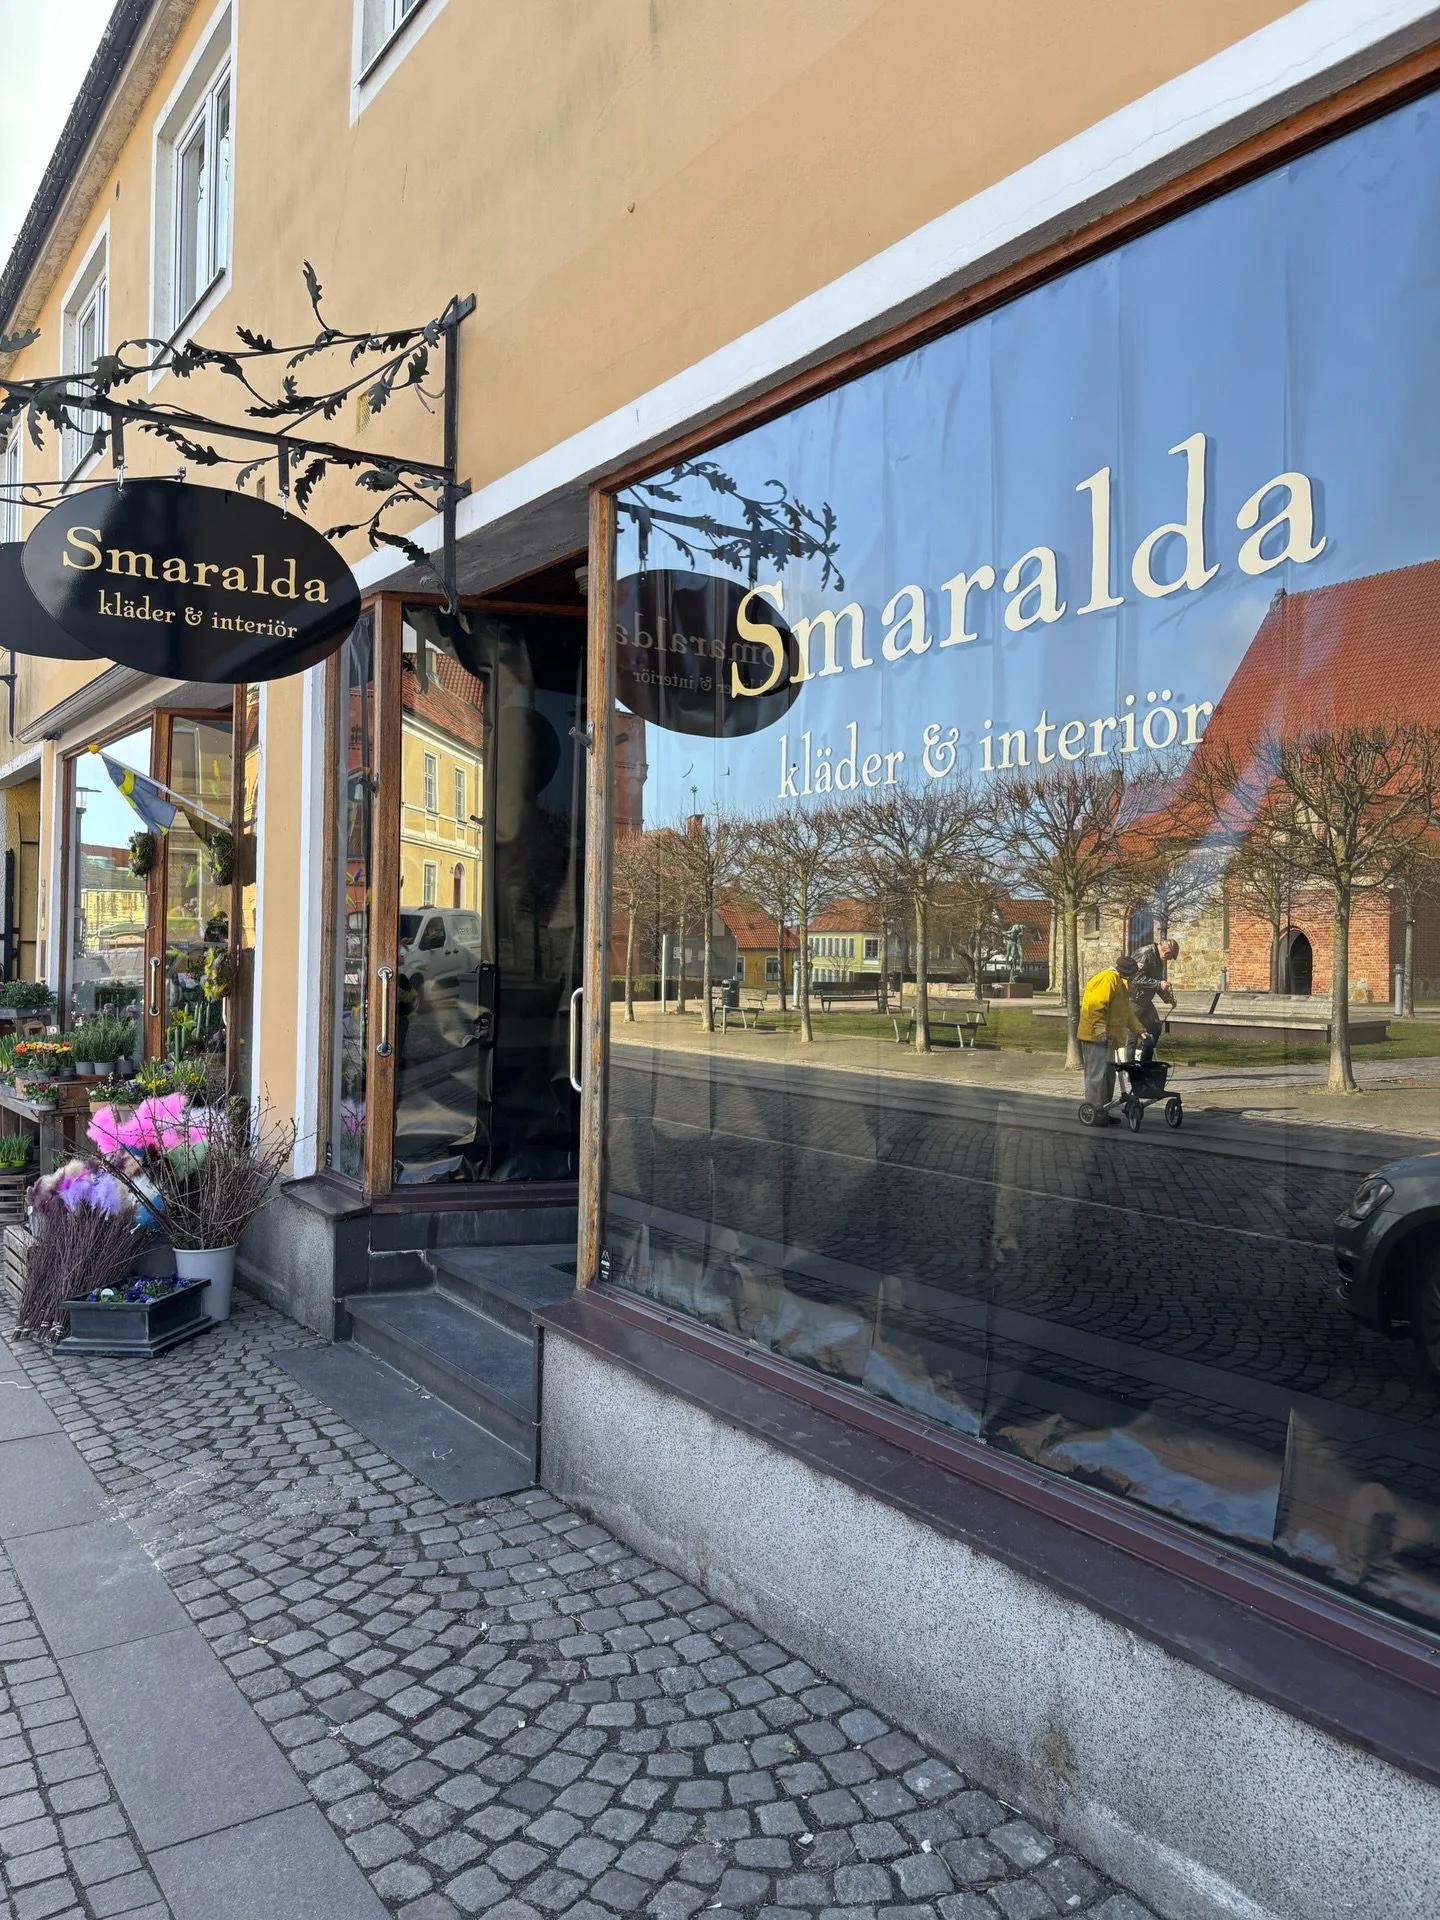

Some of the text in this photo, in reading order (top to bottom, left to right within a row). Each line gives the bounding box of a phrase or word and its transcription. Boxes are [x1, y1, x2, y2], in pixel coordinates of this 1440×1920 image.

[63, 526, 329, 604] Smaralda
[731, 432, 1328, 699] Smaralda
[98, 590, 298, 639] kläder & interiör
[777, 689, 1214, 799] kläder & interiör
